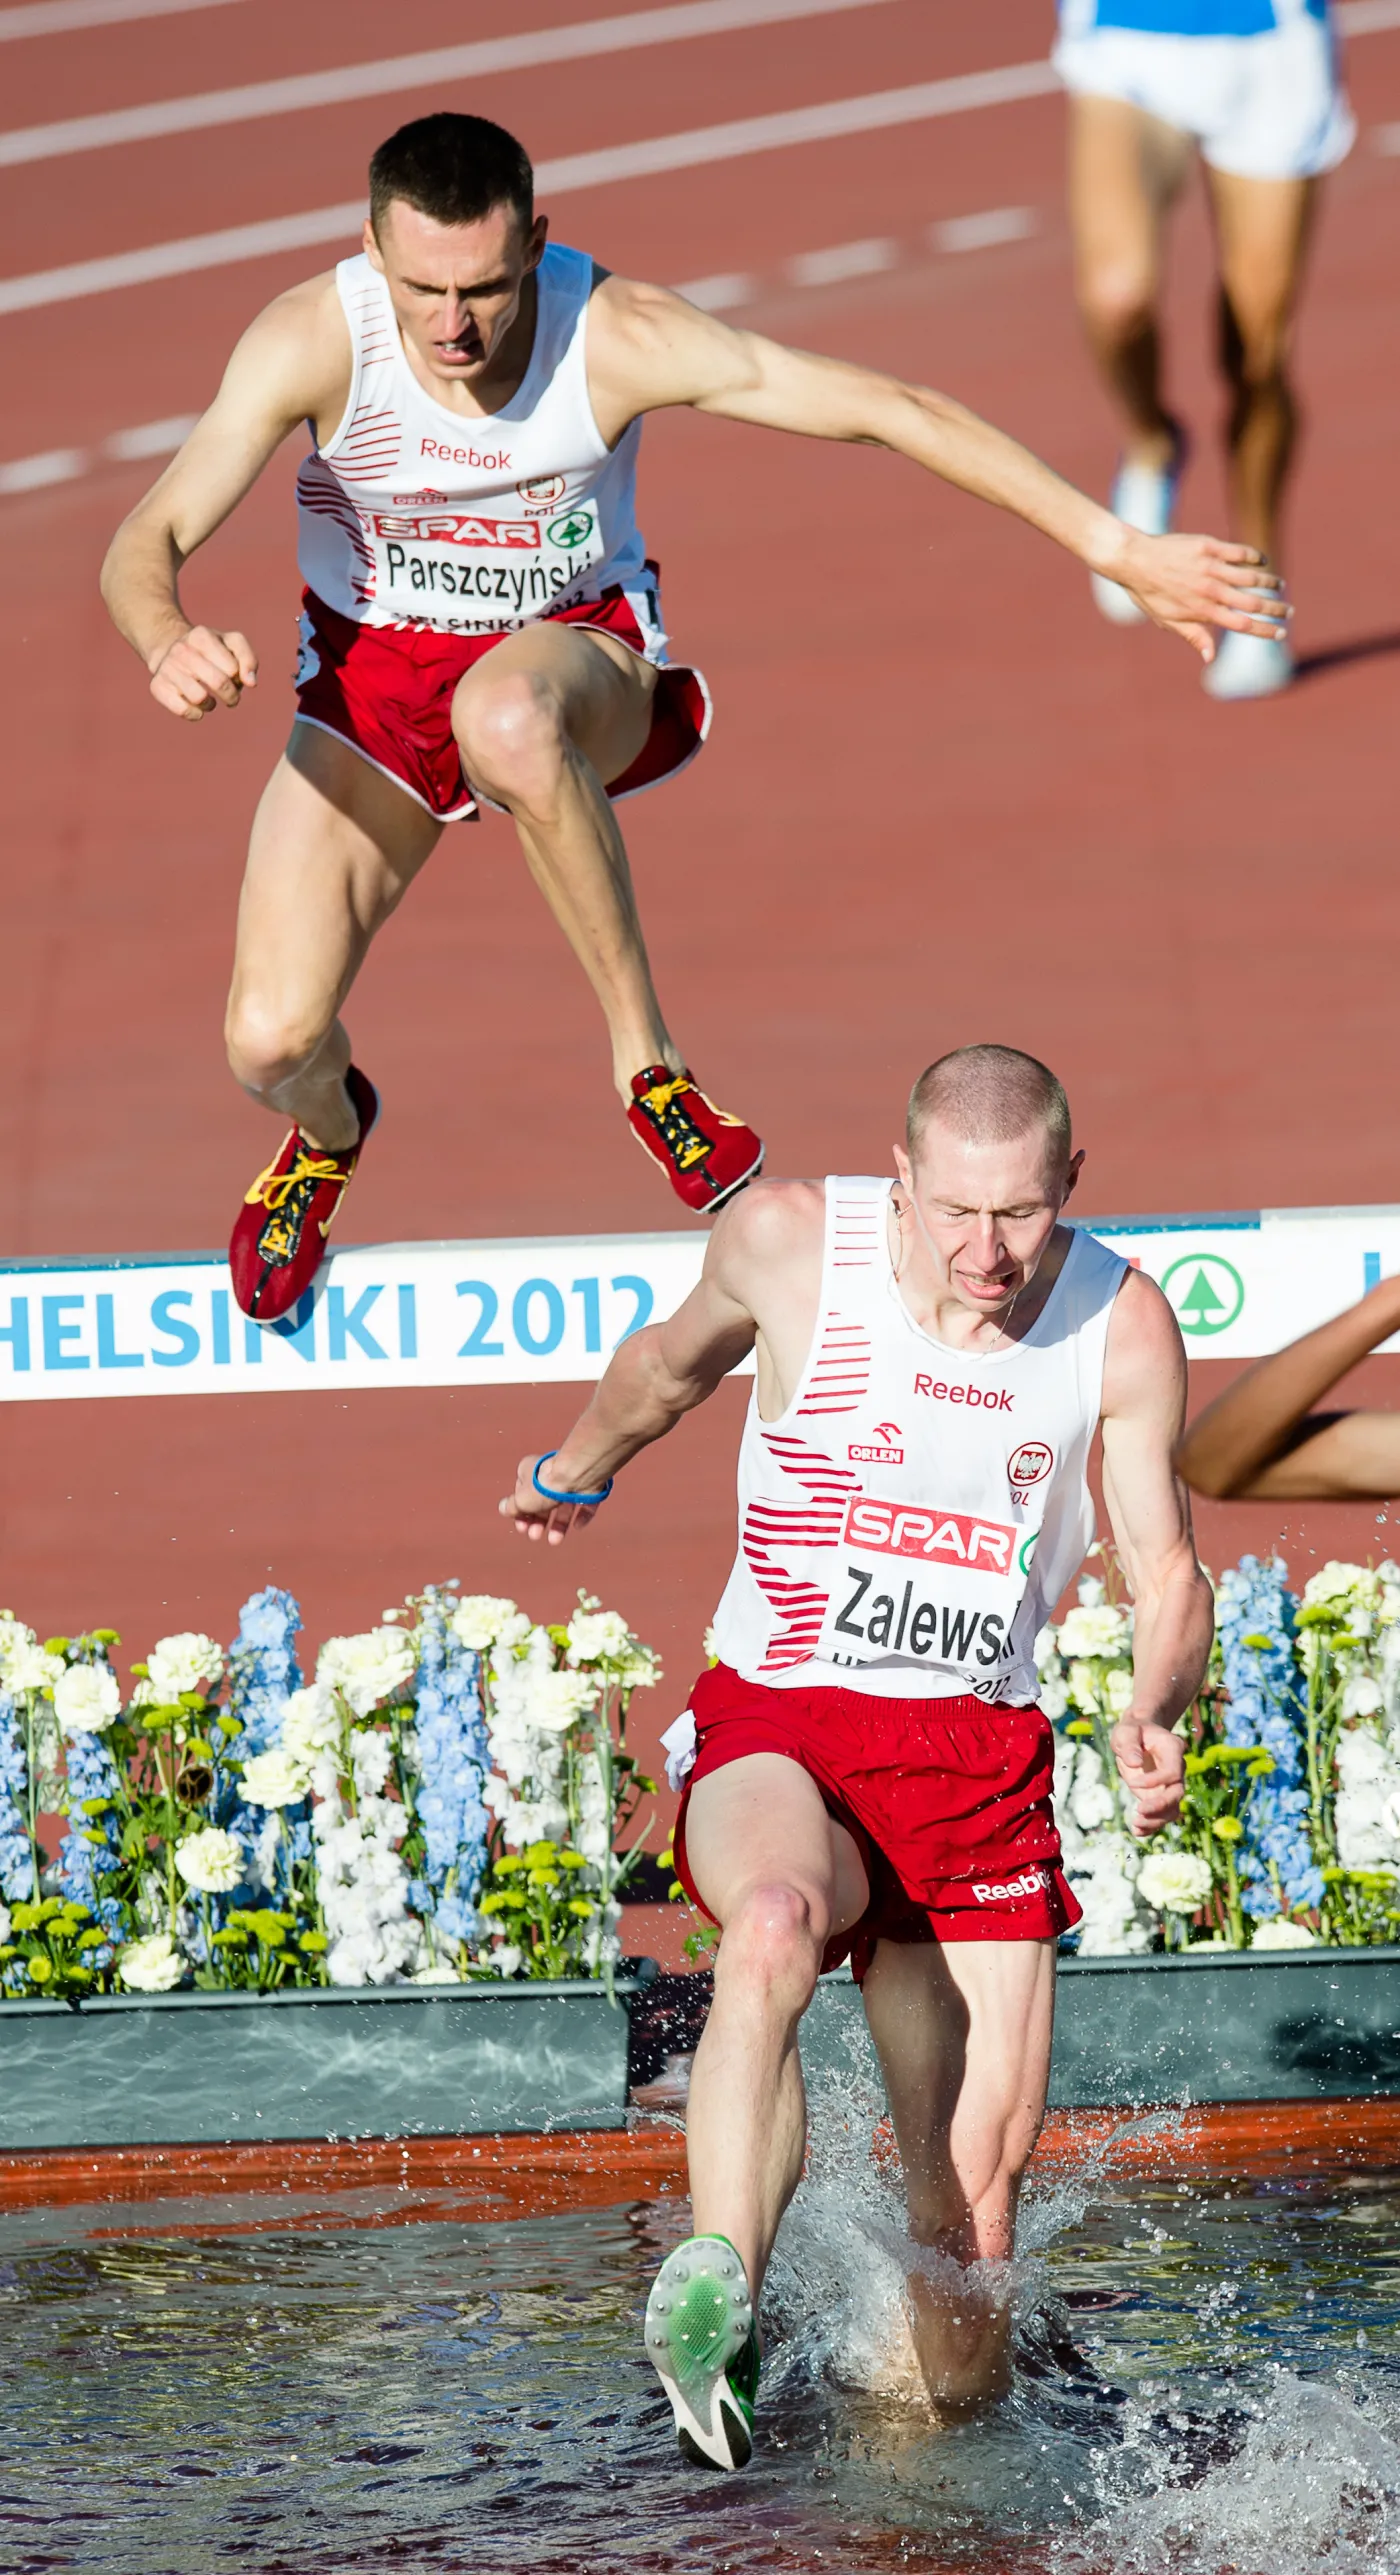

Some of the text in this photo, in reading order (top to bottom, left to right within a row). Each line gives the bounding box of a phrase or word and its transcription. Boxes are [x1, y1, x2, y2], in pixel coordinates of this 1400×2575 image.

[420, 438, 513, 470] Reebok
[378, 517, 537, 545] SPAR
[0, 1275, 654, 1371] HELSINKI 2012
[914, 1373, 1016, 1412] Reebok
[850, 1446, 901, 1462] ORLEN
[1010, 1491, 1029, 1507] OL
[850, 1505, 1010, 1567] SPAR
